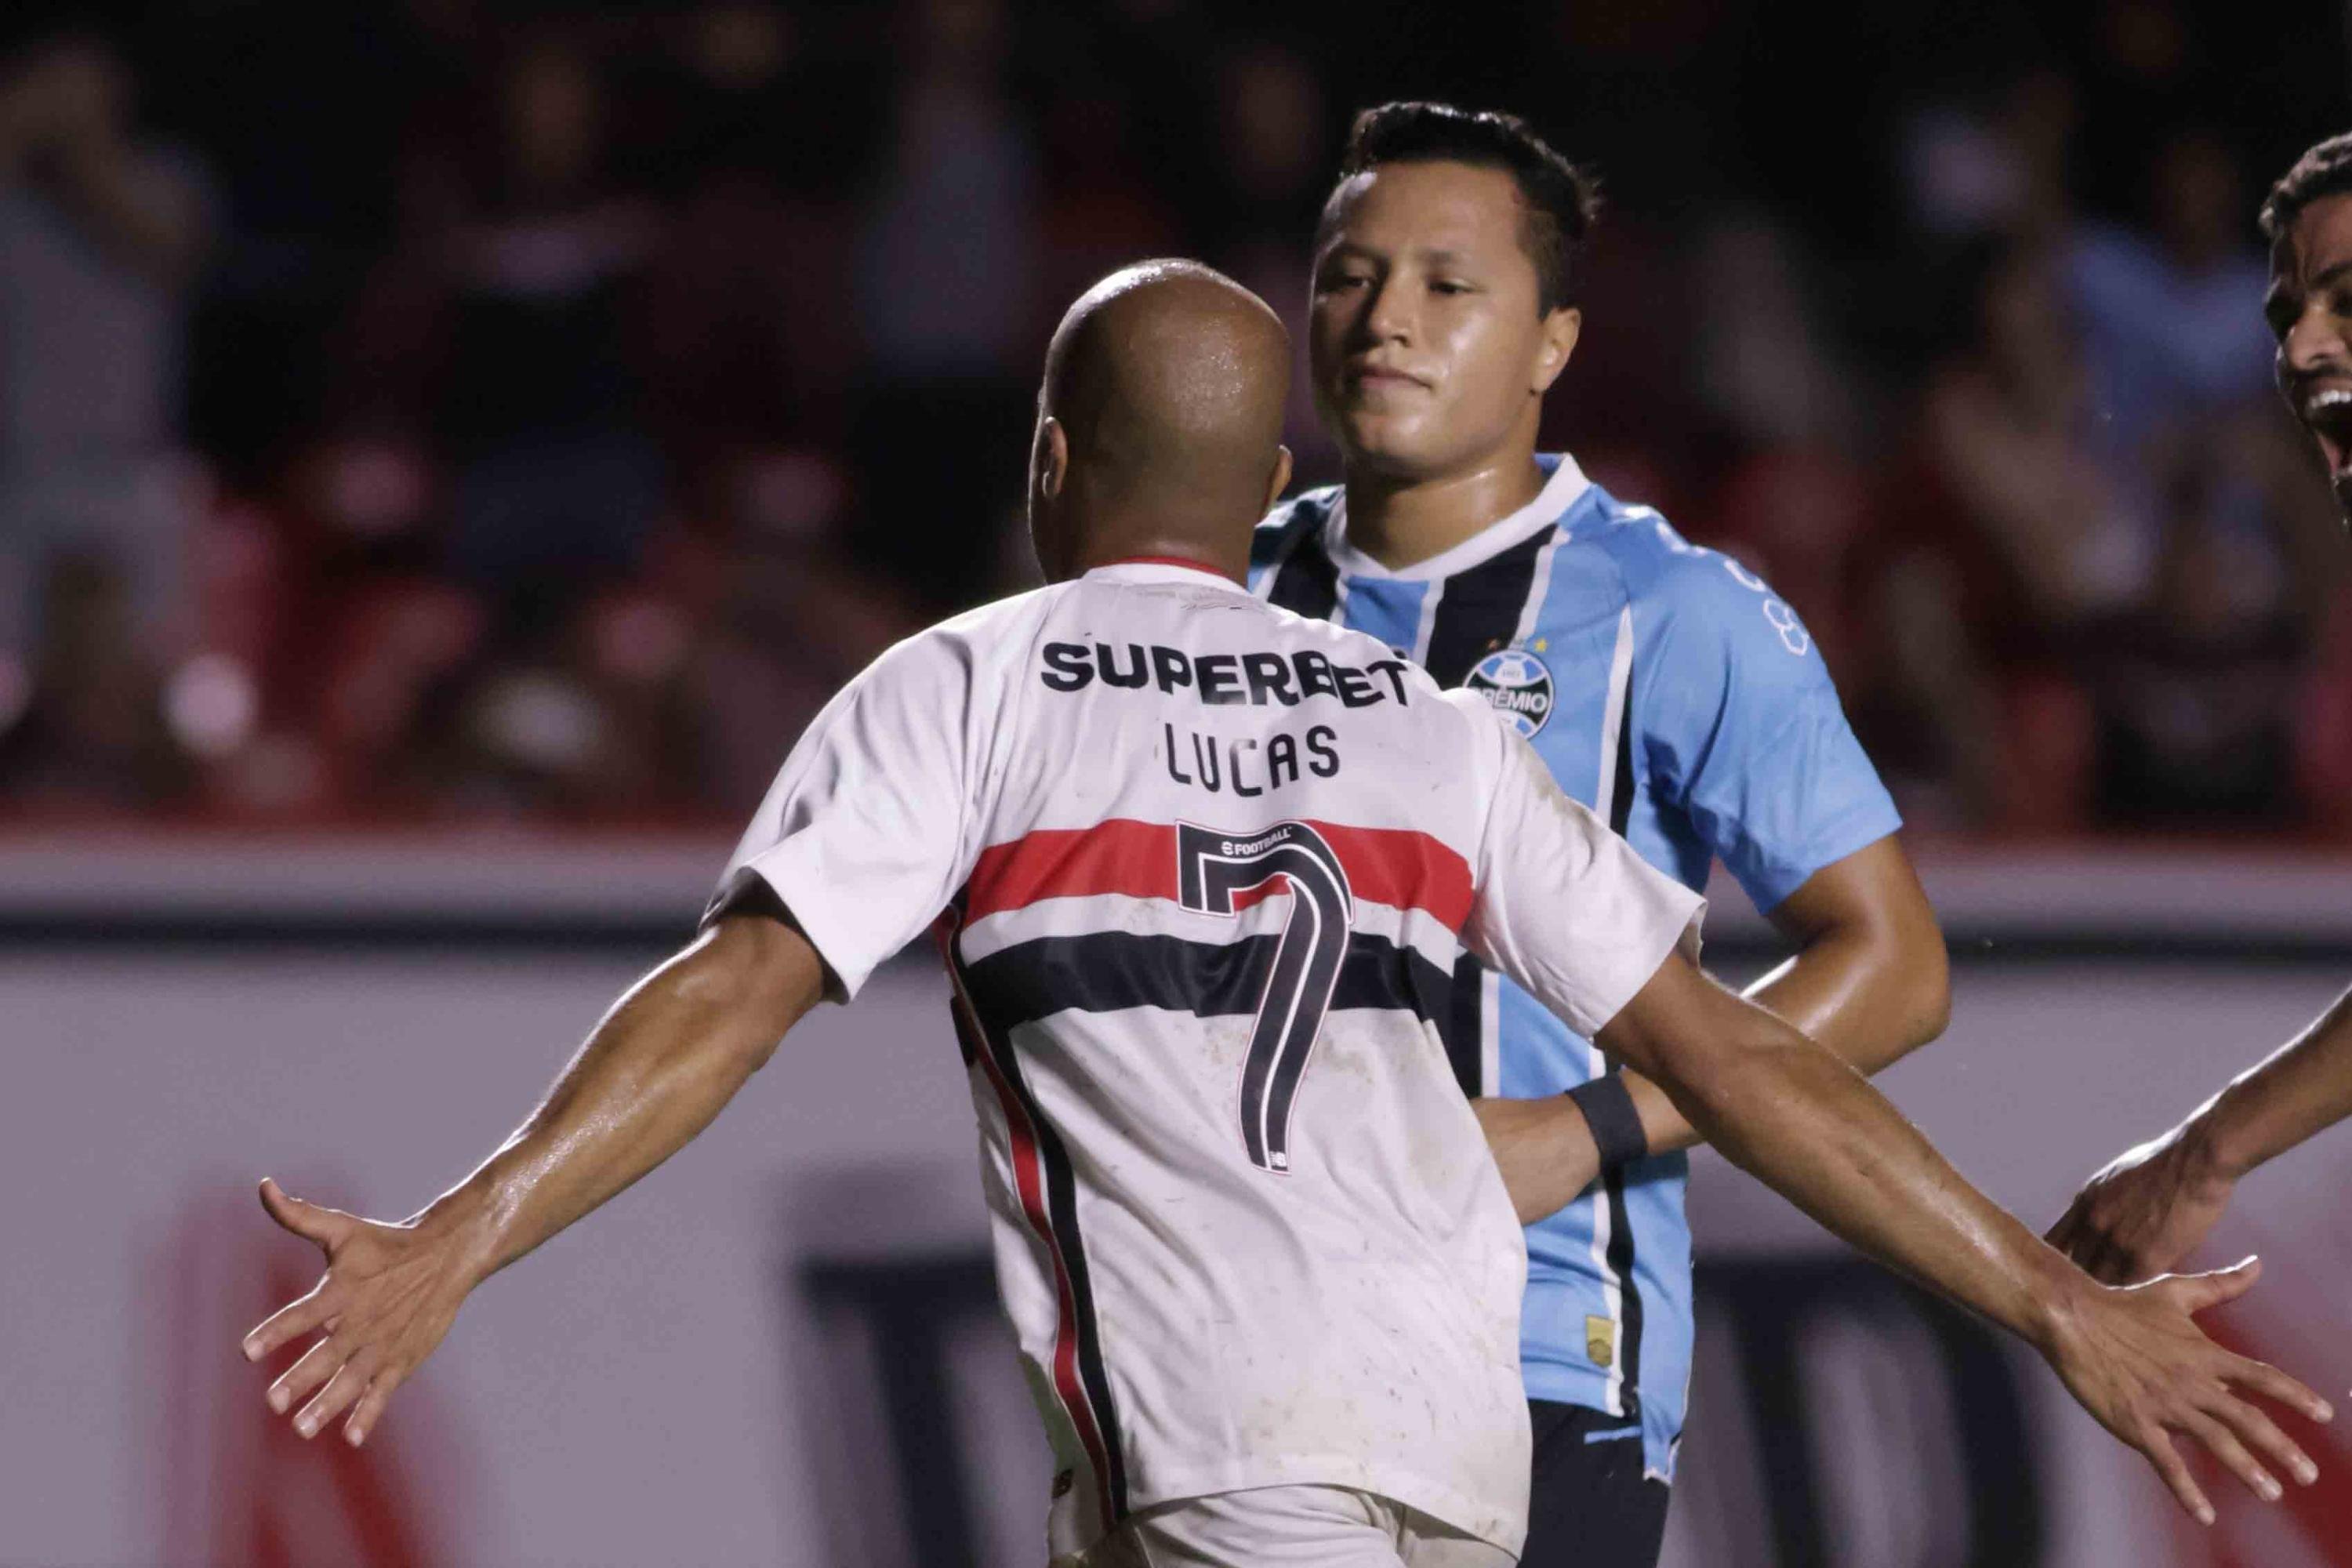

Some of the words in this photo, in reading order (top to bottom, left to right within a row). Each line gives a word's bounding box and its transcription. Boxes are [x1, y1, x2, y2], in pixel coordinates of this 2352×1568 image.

[1040, 641, 1409, 708] SUPERBET
[1165, 723, 1340, 797] LUCAS
[1177, 819, 1354, 1175] 7
